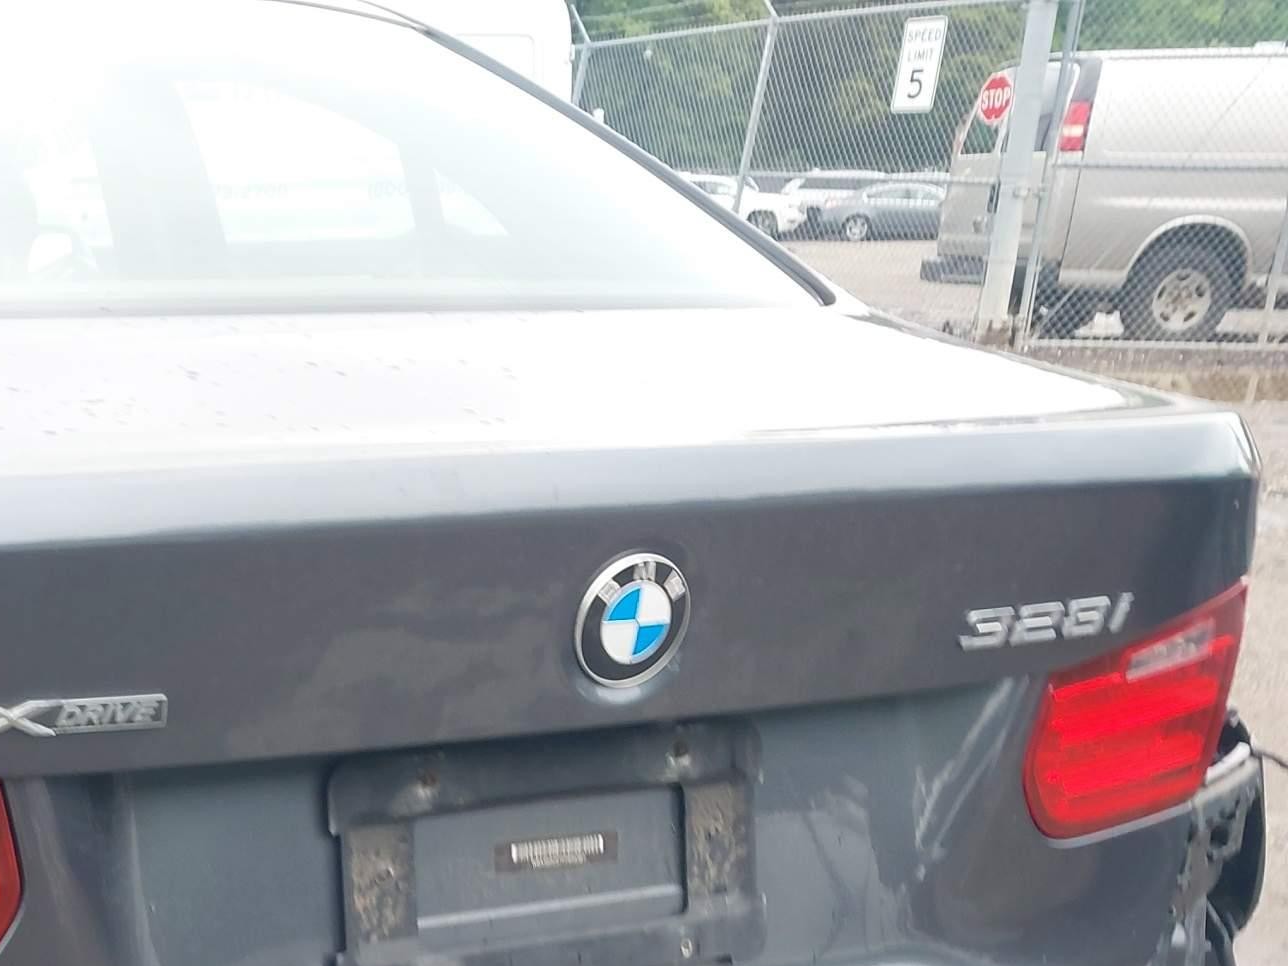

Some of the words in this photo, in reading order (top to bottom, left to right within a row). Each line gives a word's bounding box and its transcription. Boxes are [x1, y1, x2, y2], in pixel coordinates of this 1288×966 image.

[907, 27, 942, 42] SPEED
[907, 47, 934, 62] LIMIT
[907, 69, 924, 98] 5
[981, 86, 1011, 109] STOP
[598, 560, 686, 602] BMW
